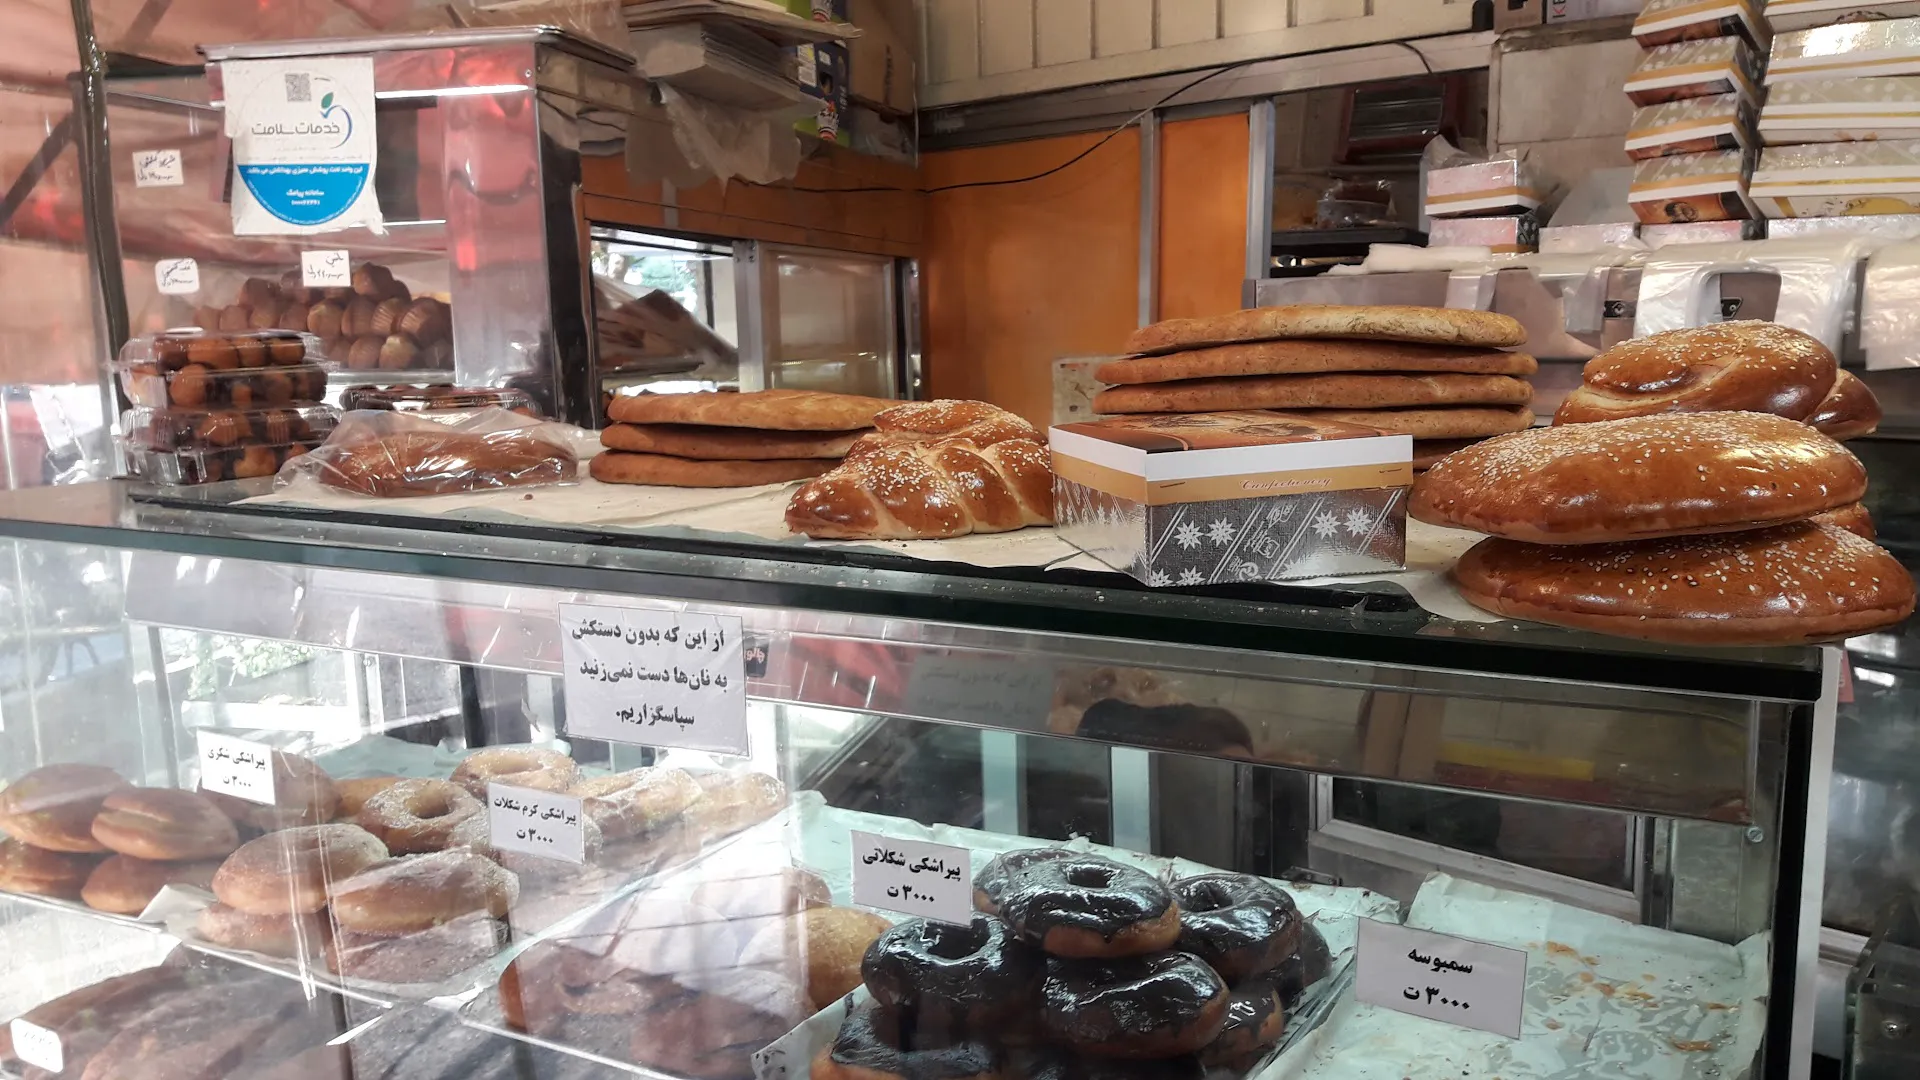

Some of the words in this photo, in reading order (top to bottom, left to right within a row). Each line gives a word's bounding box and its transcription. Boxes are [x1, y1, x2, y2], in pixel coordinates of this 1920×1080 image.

[251, 122, 295, 136] سلامت
[295, 121, 340, 135] خدمات
[571, 618, 622, 640] دستکش
[625, 627, 660, 646] بدون
[663, 626, 680, 643] که
[685, 628, 707, 650] این
[712, 629, 725, 651] از
[636, 666, 670, 682] دست
[714, 676, 728, 693] به
[615, 702, 695, 731] سپاسگزاریم.
[207, 747, 230, 761] شکری
[233, 751, 266, 771] پیراشکی
[222, 775, 230, 785] ت
[493, 797, 520, 811] شکلات
[522, 803, 539, 817] کرم
[540, 807, 577, 827] پیراشکی
[516, 828, 526, 840] ت
[528, 827, 553, 843] ۳۰۰۰
[862, 847, 906, 867] شکلاتی
[909, 857, 961, 882] پیراشکی
[886, 885, 899, 898] ت
[902, 884, 935, 903] ۳۰۰۰
[1407, 948, 1474, 974] سمبوسه
[1403, 986, 1420, 1001] ت
[1425, 985, 1470, 1010] ۳۰۰۰
